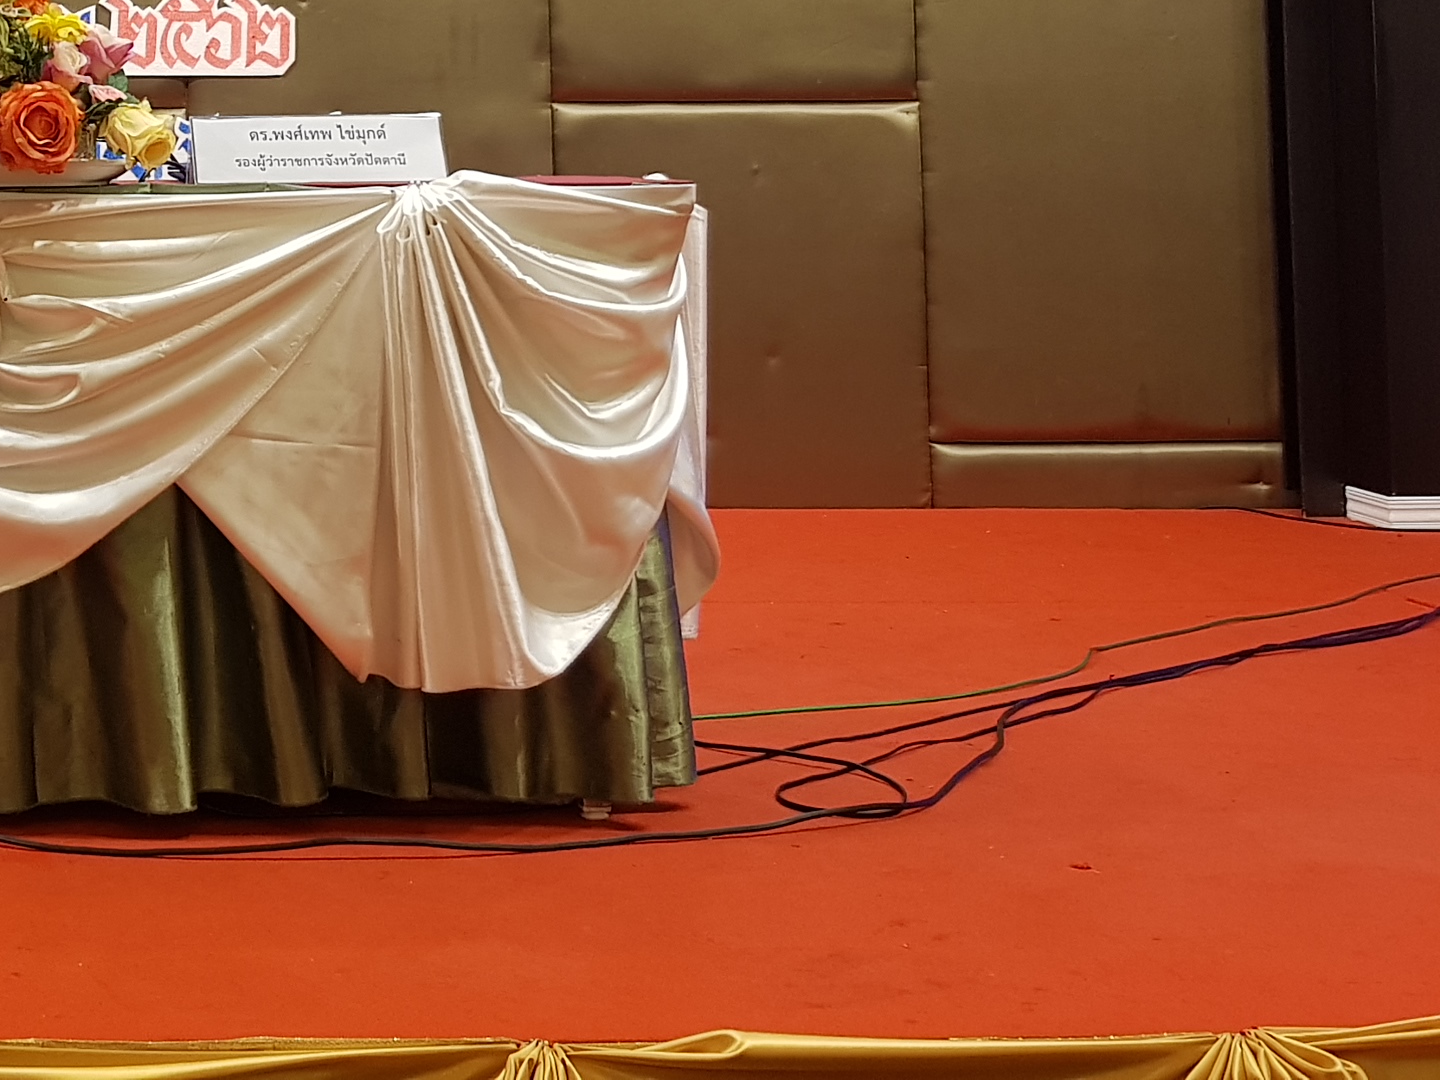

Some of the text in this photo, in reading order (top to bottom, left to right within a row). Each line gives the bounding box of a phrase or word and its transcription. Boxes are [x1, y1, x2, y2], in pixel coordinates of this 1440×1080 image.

[249, 123, 387, 145] ดร.พงศ์เทพ ไข่มุกด์
[235, 153, 407, 171] รองผู้ว่าราชการจังหวัดปัตตานี
